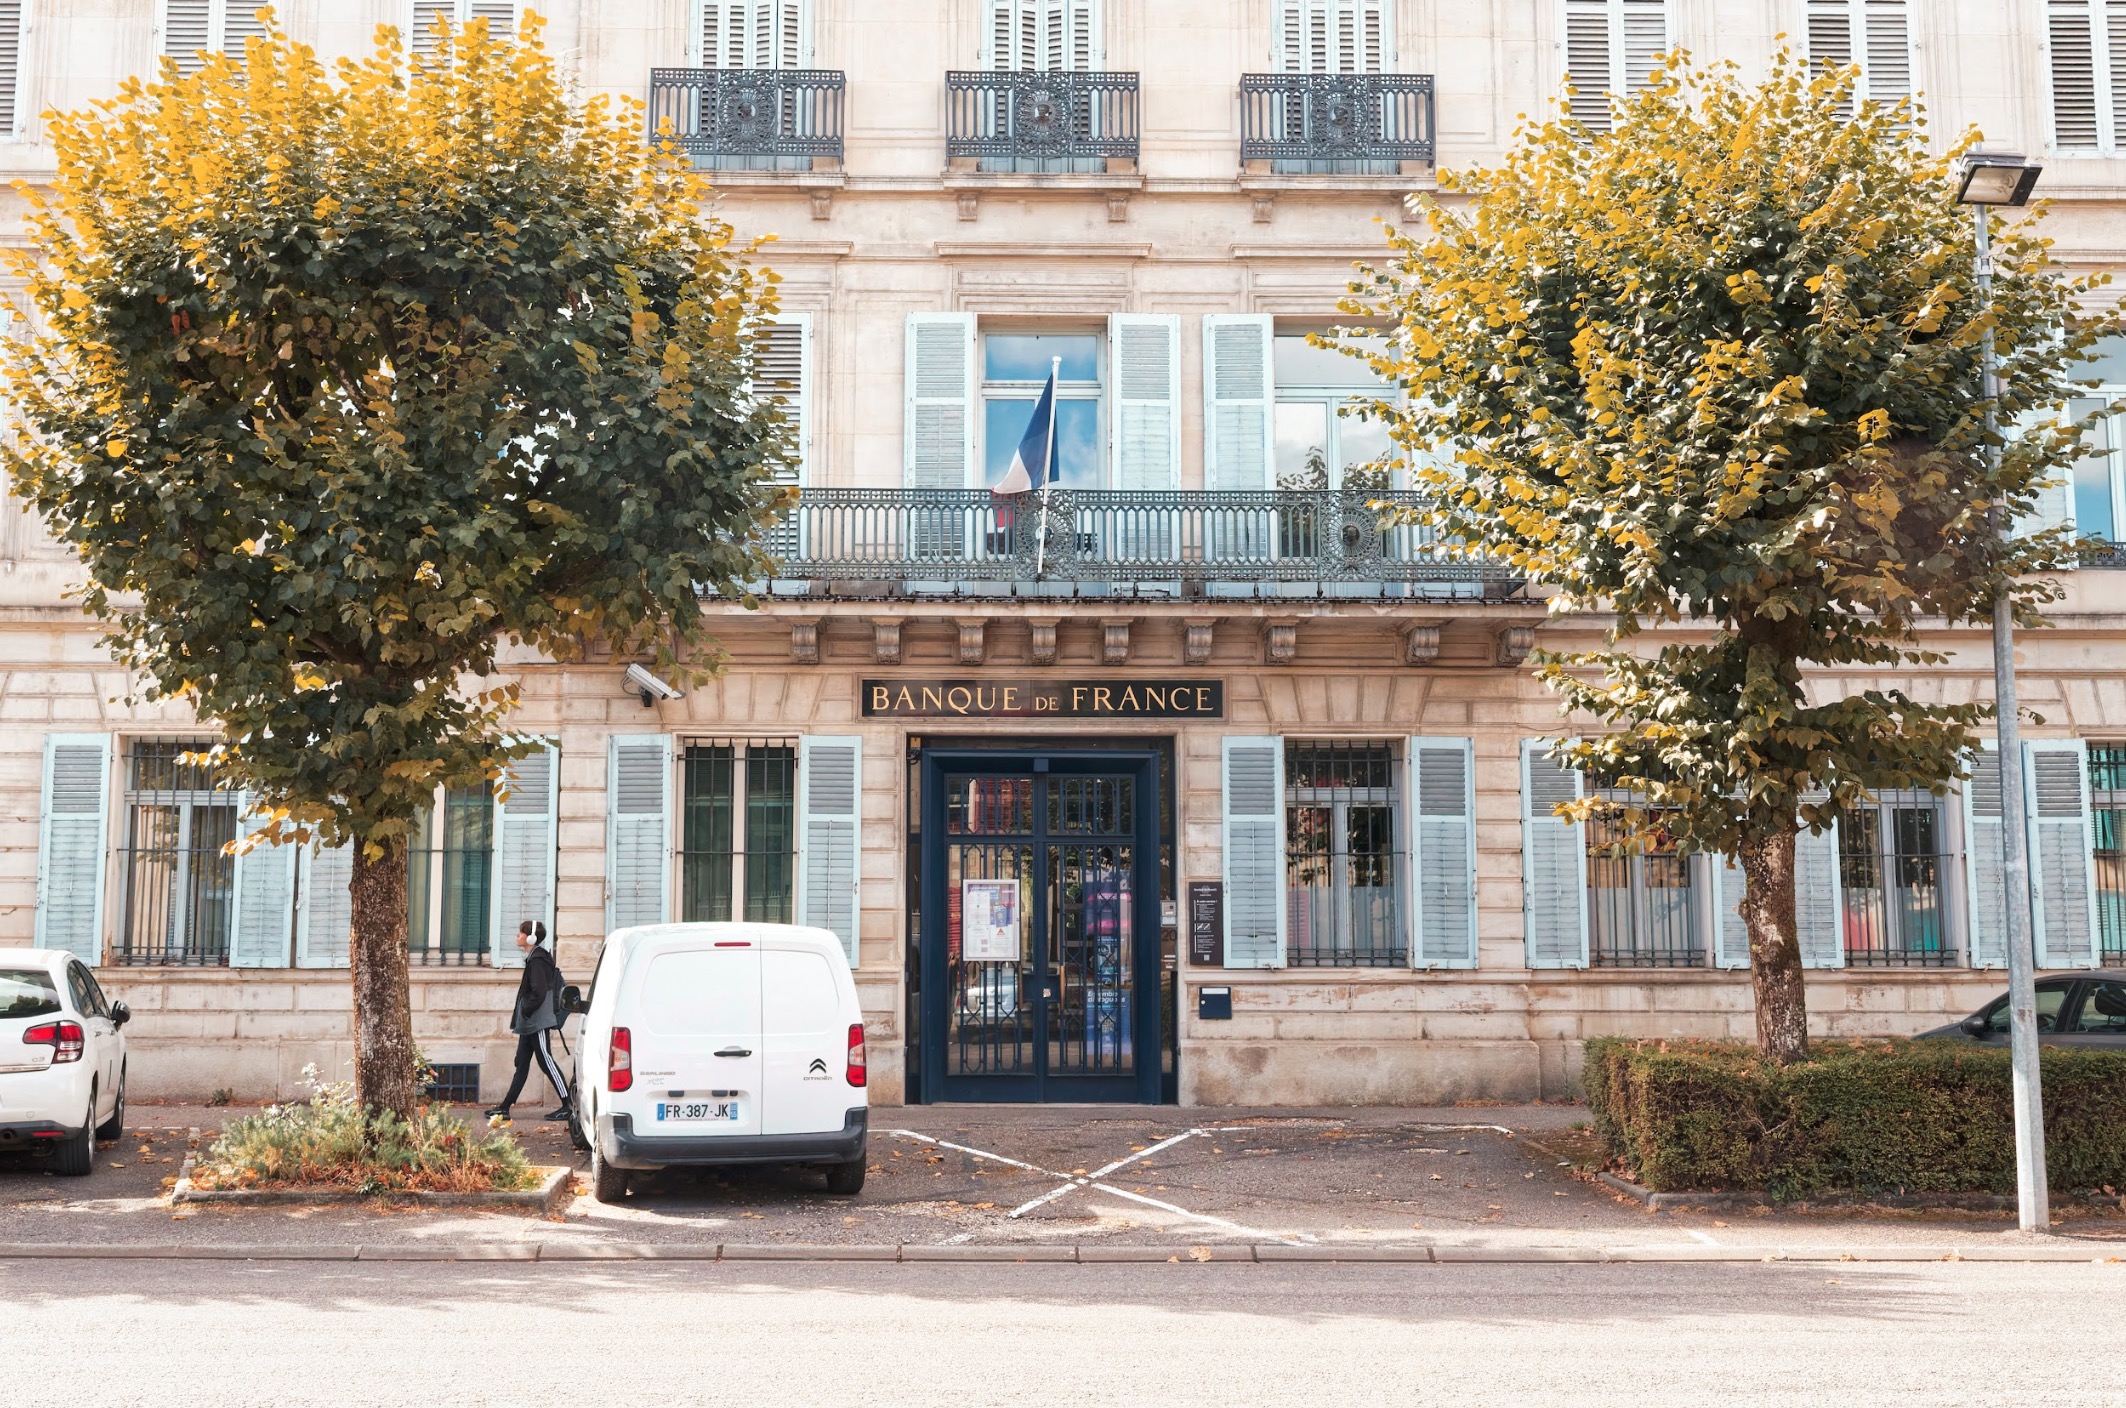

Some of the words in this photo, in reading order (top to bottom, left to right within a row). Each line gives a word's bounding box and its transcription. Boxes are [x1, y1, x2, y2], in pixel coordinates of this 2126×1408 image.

[872, 686, 1022, 715] BANQUE
[1035, 696, 1059, 711] DE
[1072, 685, 1214, 711] FRANCE
[665, 1104, 729, 1118] FR-387-JK
